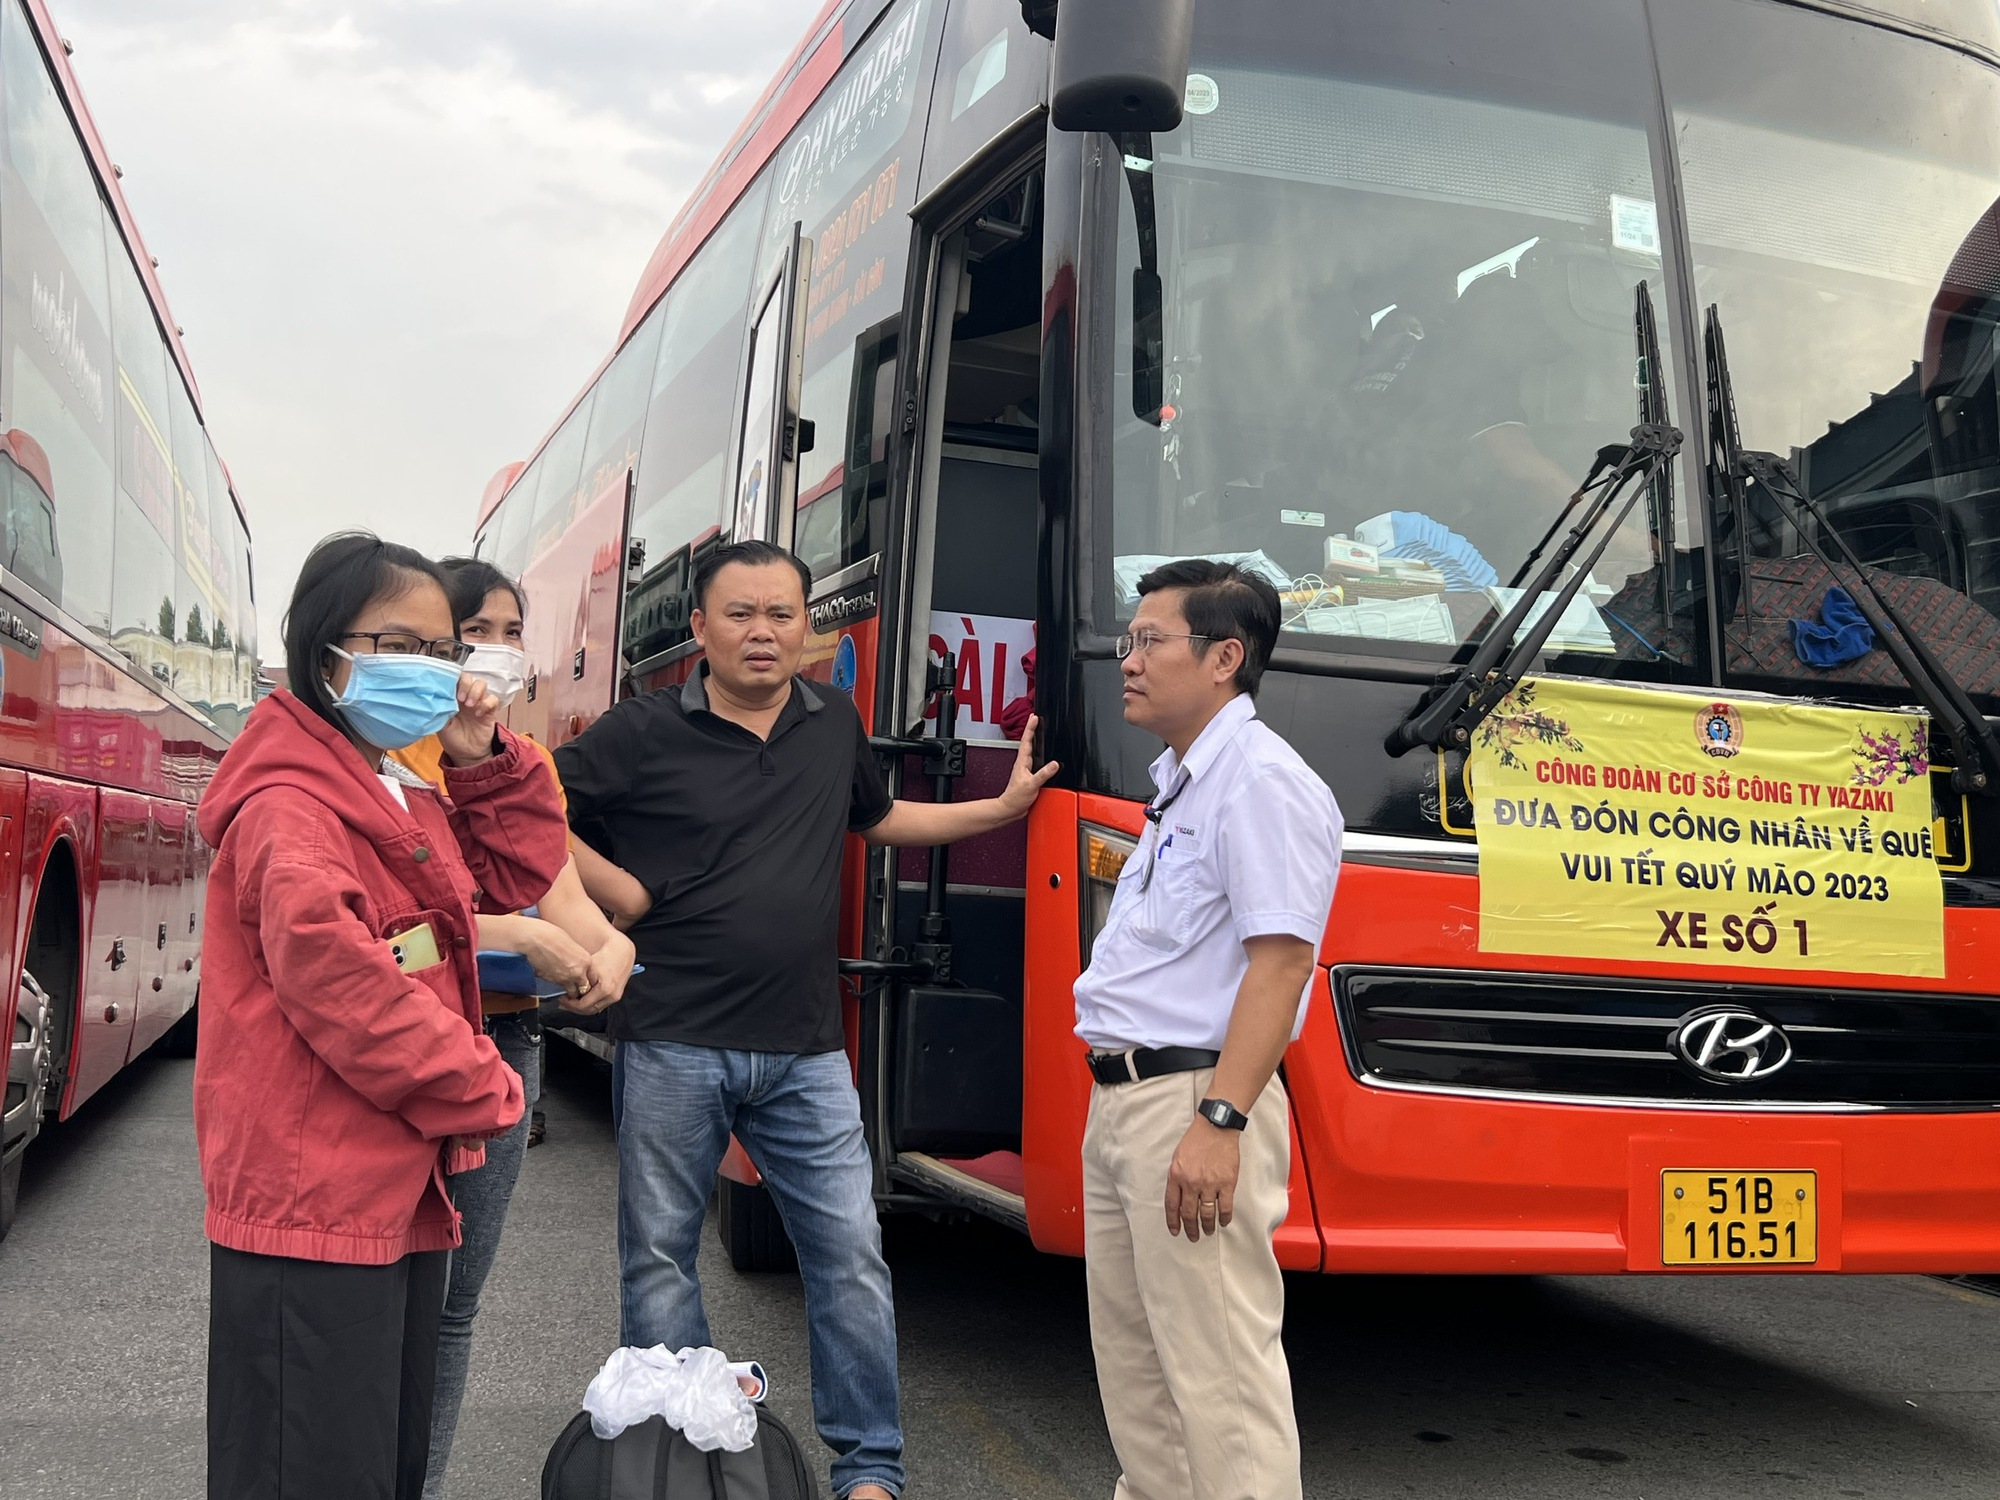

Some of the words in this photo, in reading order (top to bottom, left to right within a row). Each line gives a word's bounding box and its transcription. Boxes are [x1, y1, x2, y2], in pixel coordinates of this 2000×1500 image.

[806, 0, 921, 174] HYUNDAI
[866, 67, 906, 130] 가능성
[1537, 759, 1596, 786] CÔNG
[1603, 764, 1661, 792] ĐOÀN
[1669, 772, 1695, 795] CƠ
[1704, 769, 1730, 798] SỞ
[1738, 776, 1792, 803] CÔNG
[1800, 784, 1820, 804] TY
[1828, 787, 1893, 811] YAZAKI
[1494, 797, 1562, 829] ĐƯA
[1571, 799, 1638, 835] ĐÓN
[1649, 807, 1740, 843] CÔNG
[1751, 817, 1831, 850] NHÂN
[1839, 815, 1872, 853] VỀ
[1882, 827, 1932, 858] QUÊ
[1561, 854, 1611, 882] VUI
[1622, 847, 1665, 885] TẾT
[1676, 857, 1735, 890] QUÝ
[1748, 861, 1815, 896] MÃO
[1825, 873, 1888, 901] 2023
[1657, 911, 1707, 948] XE
[1723, 901, 1777, 953] SỐ
[1794, 920, 1807, 955] 1
[1708, 1177, 1773, 1214] 51B
[1685, 1221, 1796, 1259] 116.51
